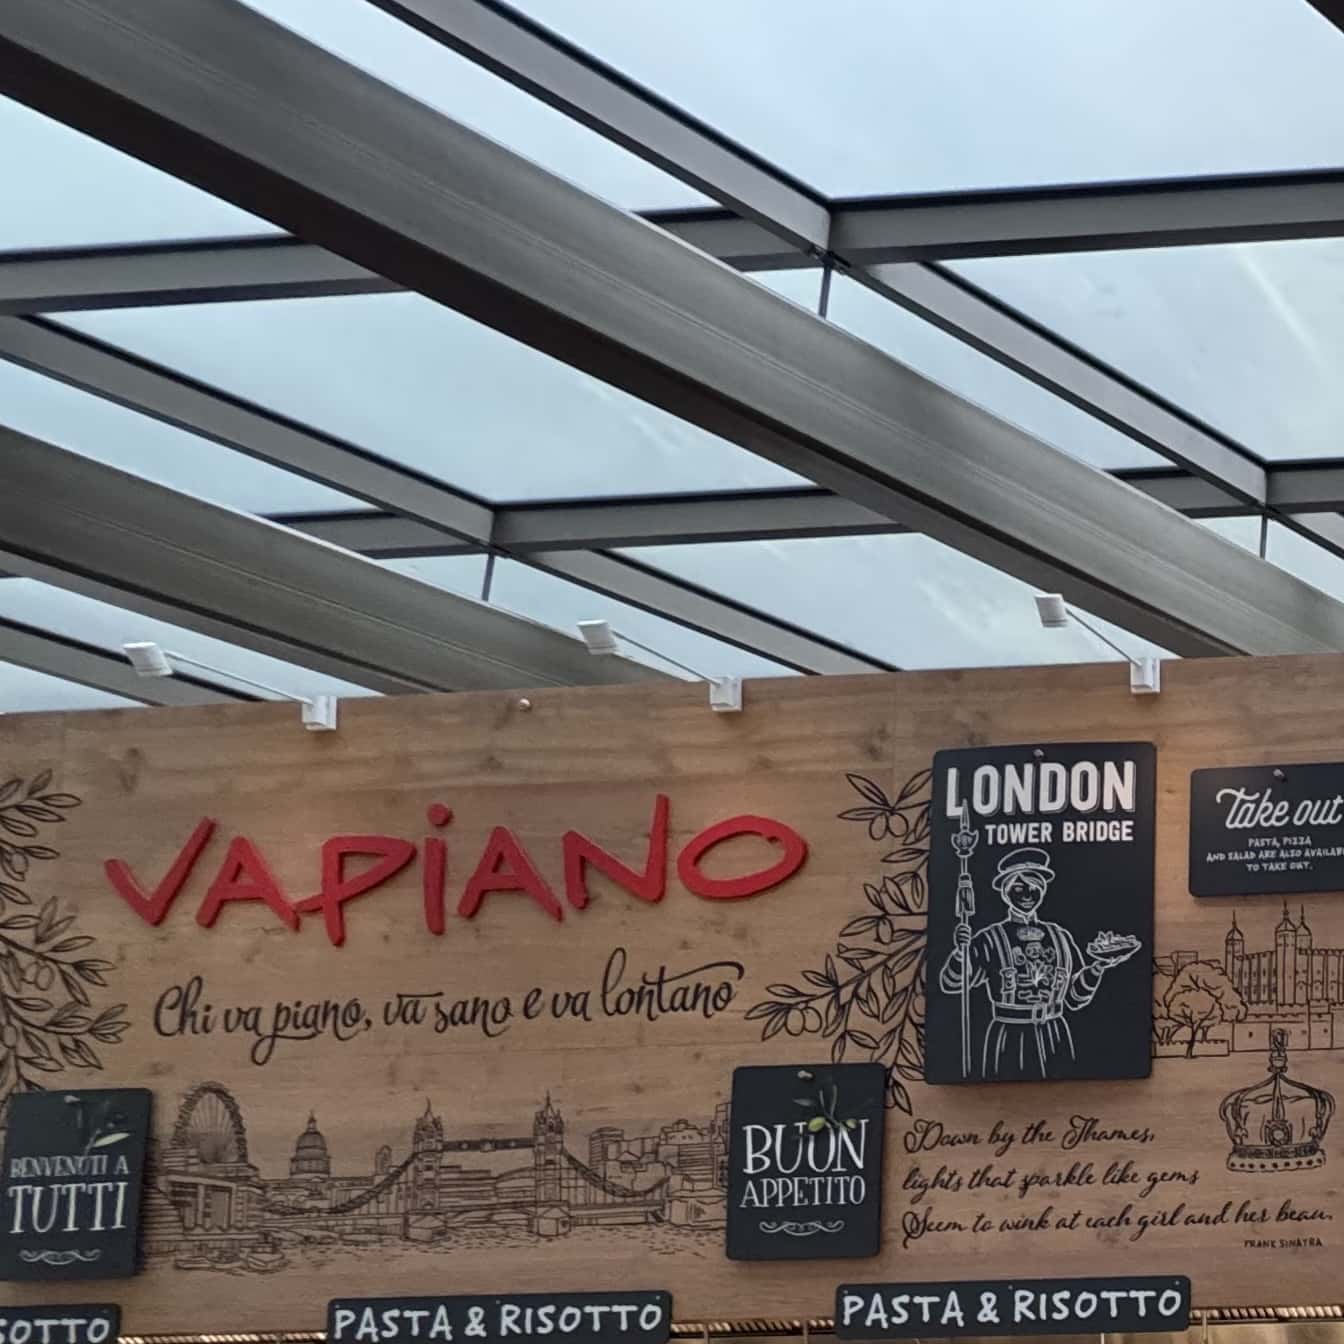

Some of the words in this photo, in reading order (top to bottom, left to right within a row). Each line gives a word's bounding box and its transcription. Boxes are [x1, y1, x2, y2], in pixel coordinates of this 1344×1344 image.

[946, 761, 1136, 819] LONDON
[1216, 787, 1290, 829] Take
[1293, 795, 1344, 825] out
[985, 822, 1052, 845] TOWER
[1062, 820, 1134, 842] BRIDGE
[1206, 852, 1225, 862] AND
[1228, 851, 1256, 861] SALAD
[1279, 849, 1302, 859] ALSO
[1246, 863, 1259, 872] TO
[1262, 862, 1286, 871] TAKE
[153, 976, 216, 1036] Chi
[223, 1006, 262, 1036] va
[251, 998, 372, 1066] piano,
[383, 992, 444, 1026] va
[433, 996, 514, 1038] sano
[522, 988, 543, 1020] e
[551, 989, 592, 1022] va
[600, 947, 745, 1022] lontano
[742, 1119, 870, 1174] BUON
[904, 1118, 981, 1153] Down
[988, 1121, 1014, 1157] by
[1022, 1120, 1055, 1145] the
[1061, 1115, 1155, 1150] Thames,
[10, 1155, 108, 1178] BENVENUTI
[114, 1155, 129, 1175] A
[902, 1165, 963, 1204] lights
[967, 1164, 1016, 1190] that
[1019, 1162, 1096, 1198] sparkle
[1102, 1160, 1140, 1187] like
[1139, 1169, 1201, 1198] gems
[8, 1182, 129, 1233] TUTTI
[739, 1175, 866, 1208] APPETITO
[902, 1207, 968, 1249] Seem
[971, 1213, 992, 1233] to
[999, 1206, 1052, 1232] wink
[1055, 1209, 1082, 1229] at
[1085, 1204, 1133, 1228] each
[1130, 1203, 1187, 1241] girl
[1184, 1201, 1233, 1226] and
[1234, 1200, 1270, 1224] her
[1244, 1239, 1276, 1249] FRANK
[1279, 1237, 1322, 1248] SINATRA
[334, 1304, 452, 1342] PASTA
[465, 1306, 487, 1337] &
[500, 1303, 662, 1337] RISOTTO
[843, 1291, 964, 1329] PASTA
[977, 1291, 1000, 1324] &
[1014, 1289, 1182, 1323] RISOTTO
